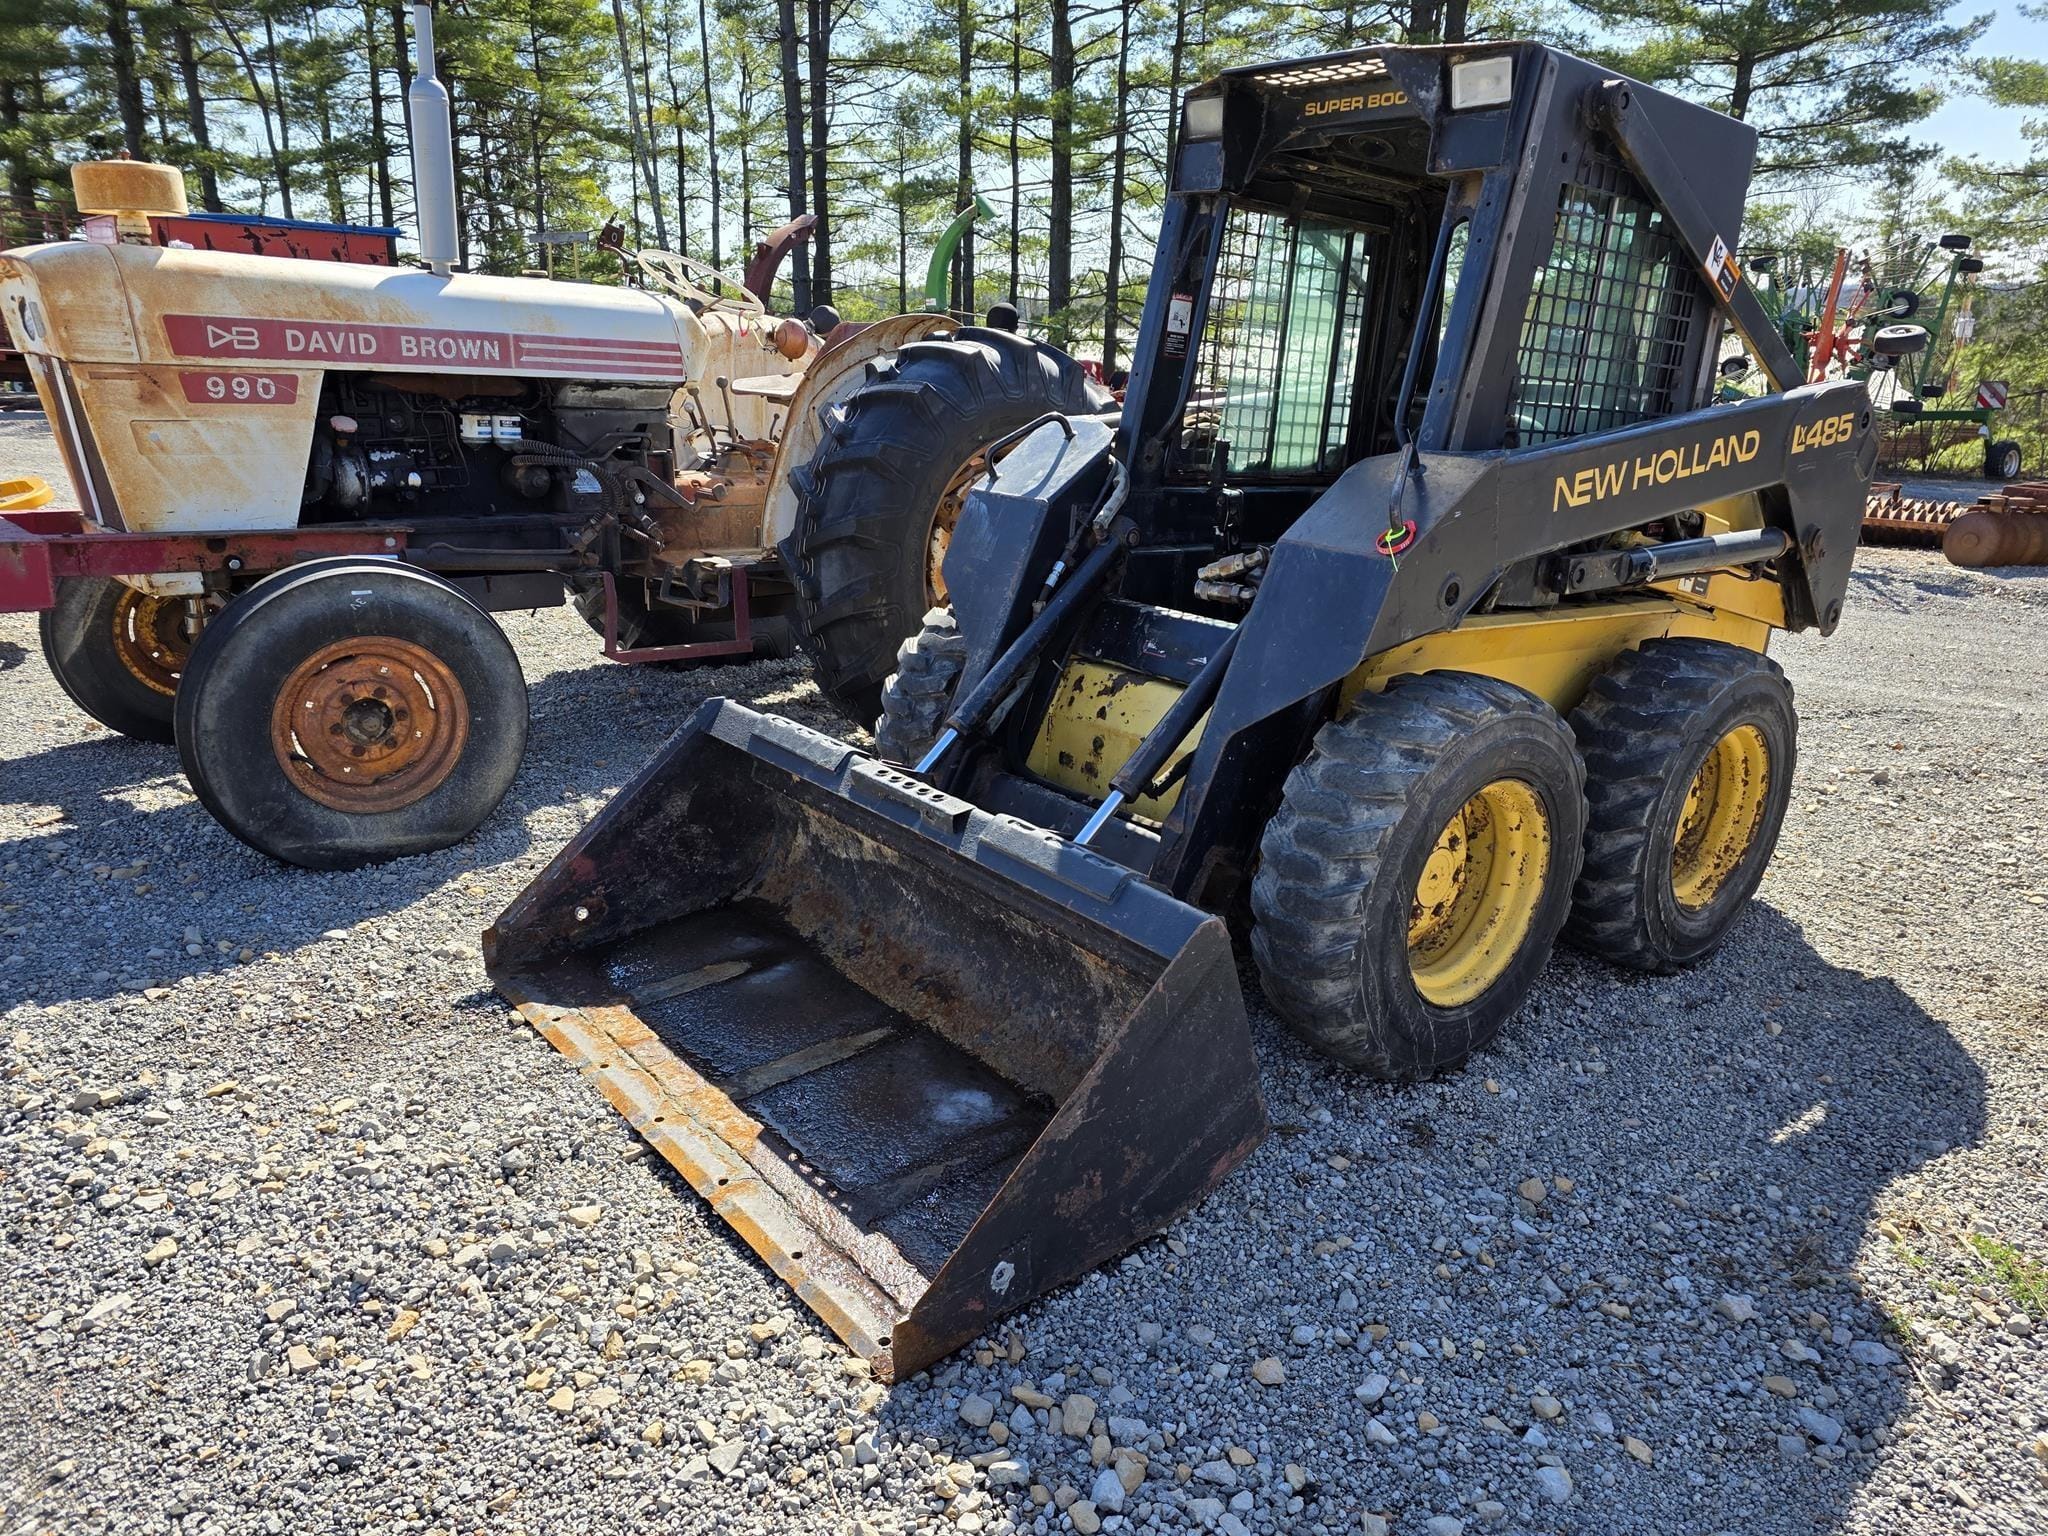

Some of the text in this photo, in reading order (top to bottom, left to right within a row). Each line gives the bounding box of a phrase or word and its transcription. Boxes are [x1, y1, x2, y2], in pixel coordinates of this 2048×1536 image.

[1304, 91, 1408, 116] SUPER BOO
[285, 328, 377, 355] DAVID
[400, 335, 500, 361] BROWN
[205, 376, 276, 400] 990
[1553, 460, 1628, 512] NEW
[1632, 429, 1761, 491] HOLLAND
